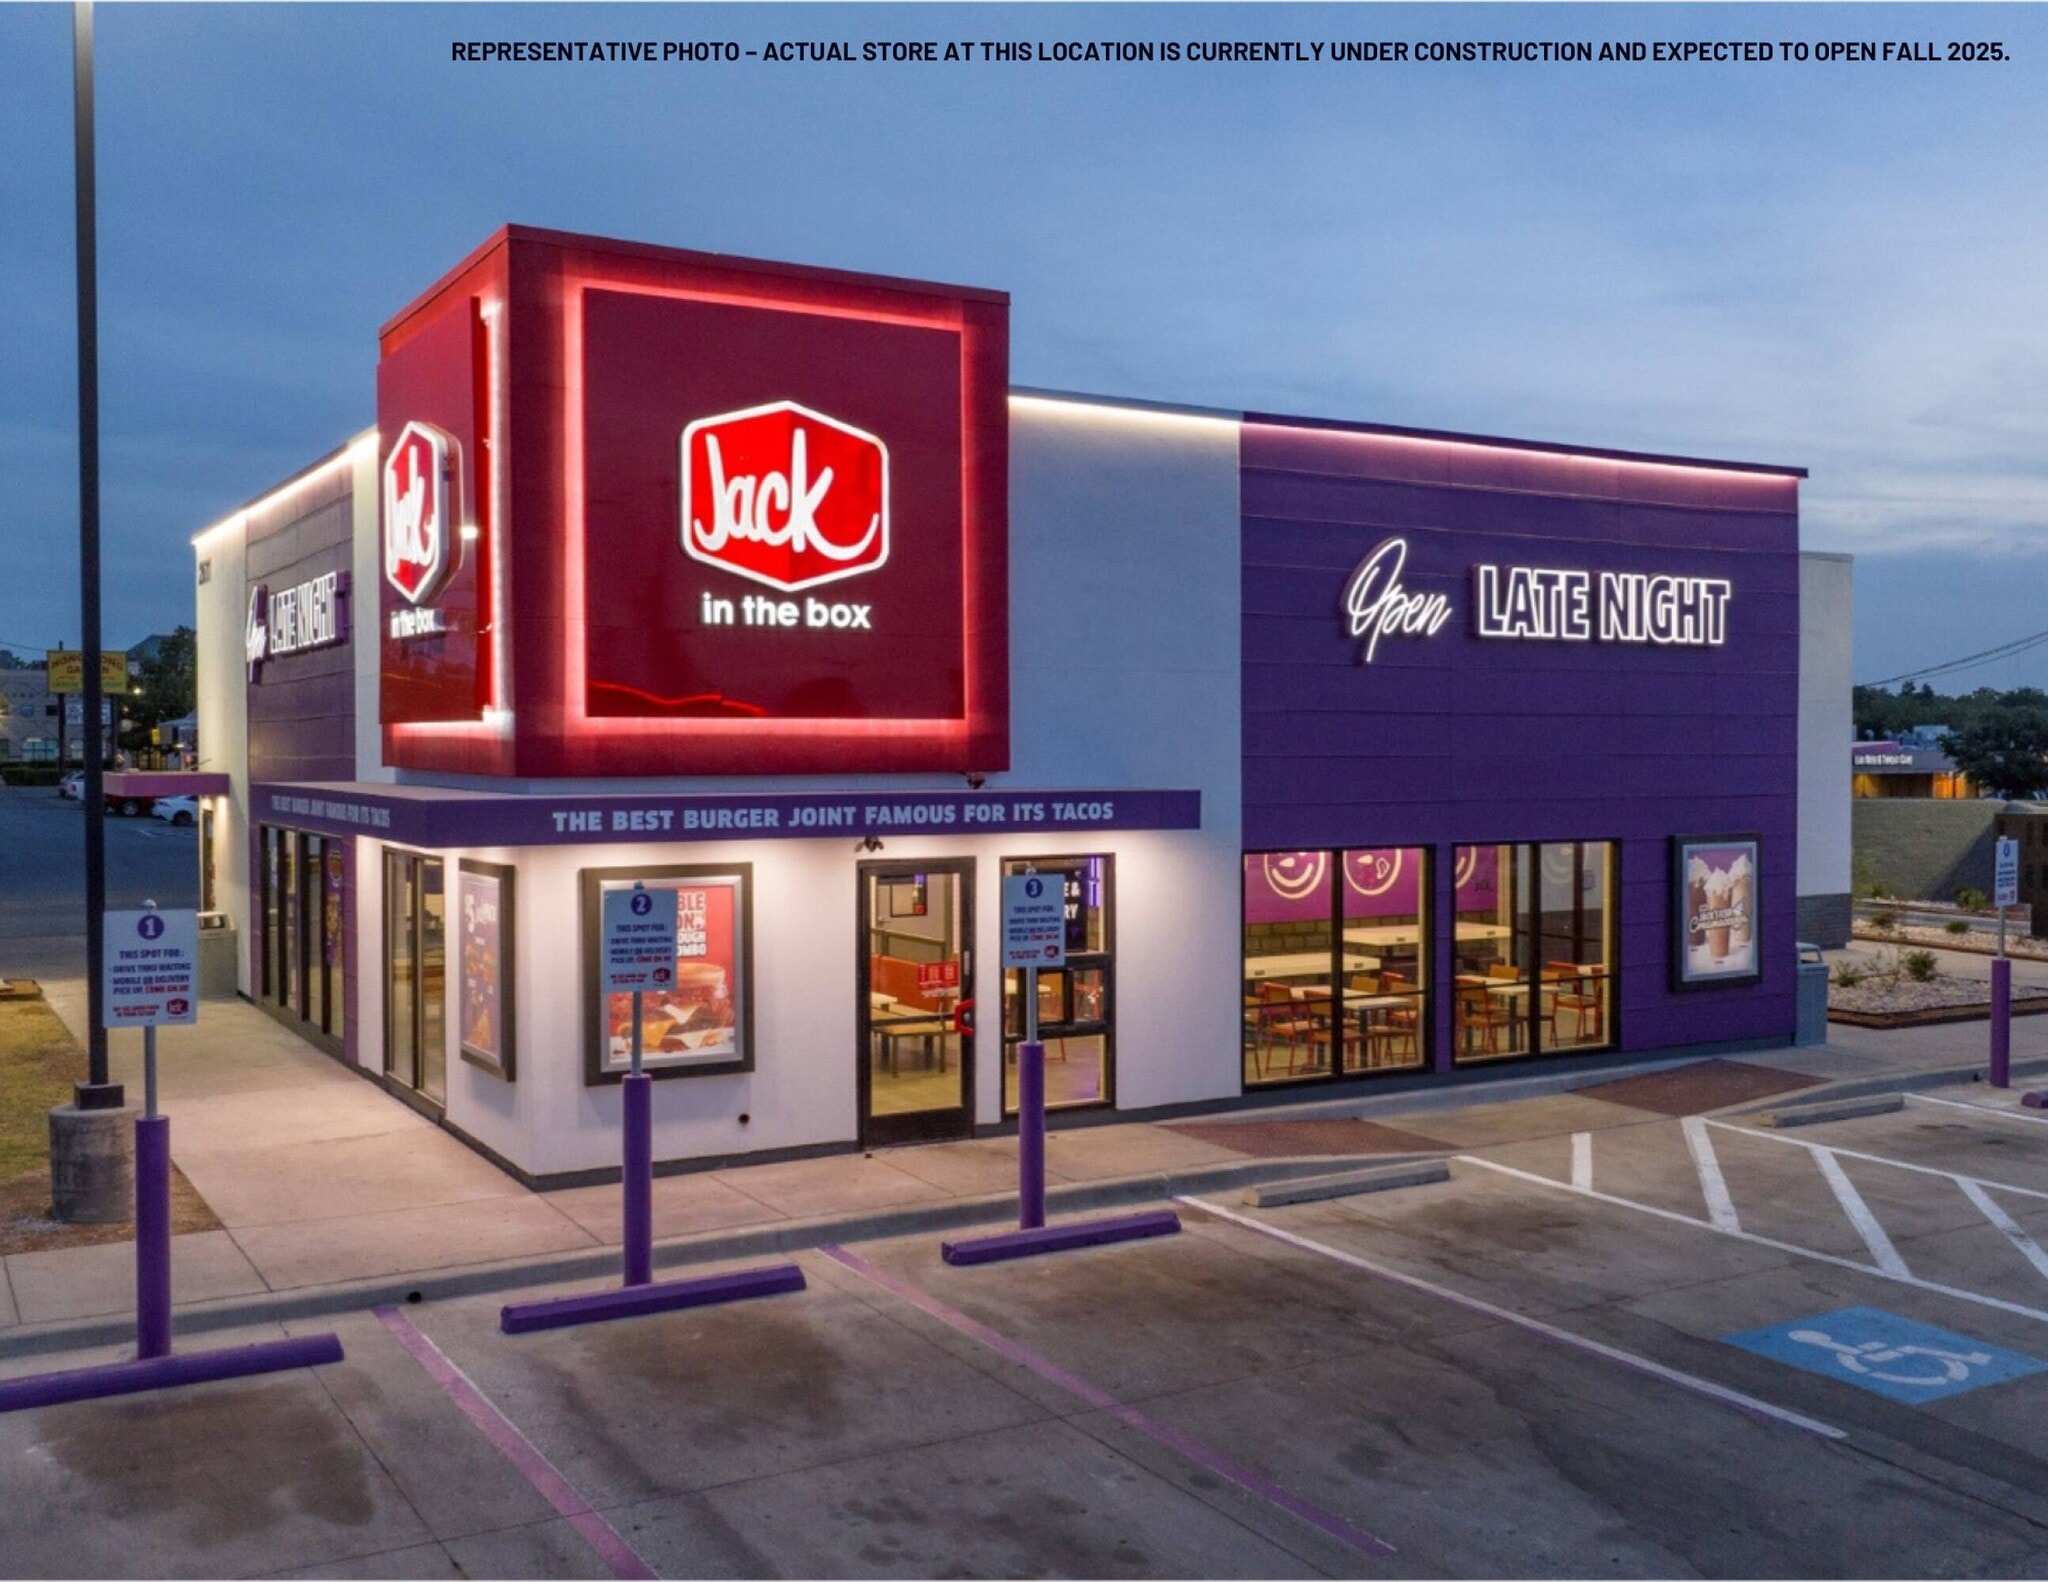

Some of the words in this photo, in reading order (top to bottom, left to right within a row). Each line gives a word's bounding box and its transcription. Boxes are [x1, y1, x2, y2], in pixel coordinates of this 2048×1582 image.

[693, 428, 880, 561] Jack
[269, 587, 297, 654] LATE
[297, 570, 338, 647] NIGHT
[703, 592, 733, 625] in
[742, 596, 800, 627] the
[806, 597, 872, 629] box
[1347, 538, 1452, 663] Open
[1478, 565, 1590, 640] LATE
[1600, 572, 1732, 645] NIGHT
[553, 811, 603, 832] THE
[612, 810, 674, 831] BEST
[684, 808, 779, 829] BURGER
[788, 805, 856, 827] JOINT
[865, 804, 956, 825] FAMOUS
[963, 803, 1006, 823] FOR
[1013, 802, 1045, 821] ITS
[1053, 801, 1114, 820] TACOS
[1030, 881, 1039, 894] 3
[636, 896, 646, 912] 2
[146, 918, 155, 936] 1
[119, 950, 138, 959] THIS
[140, 949, 161, 958] SPOT
